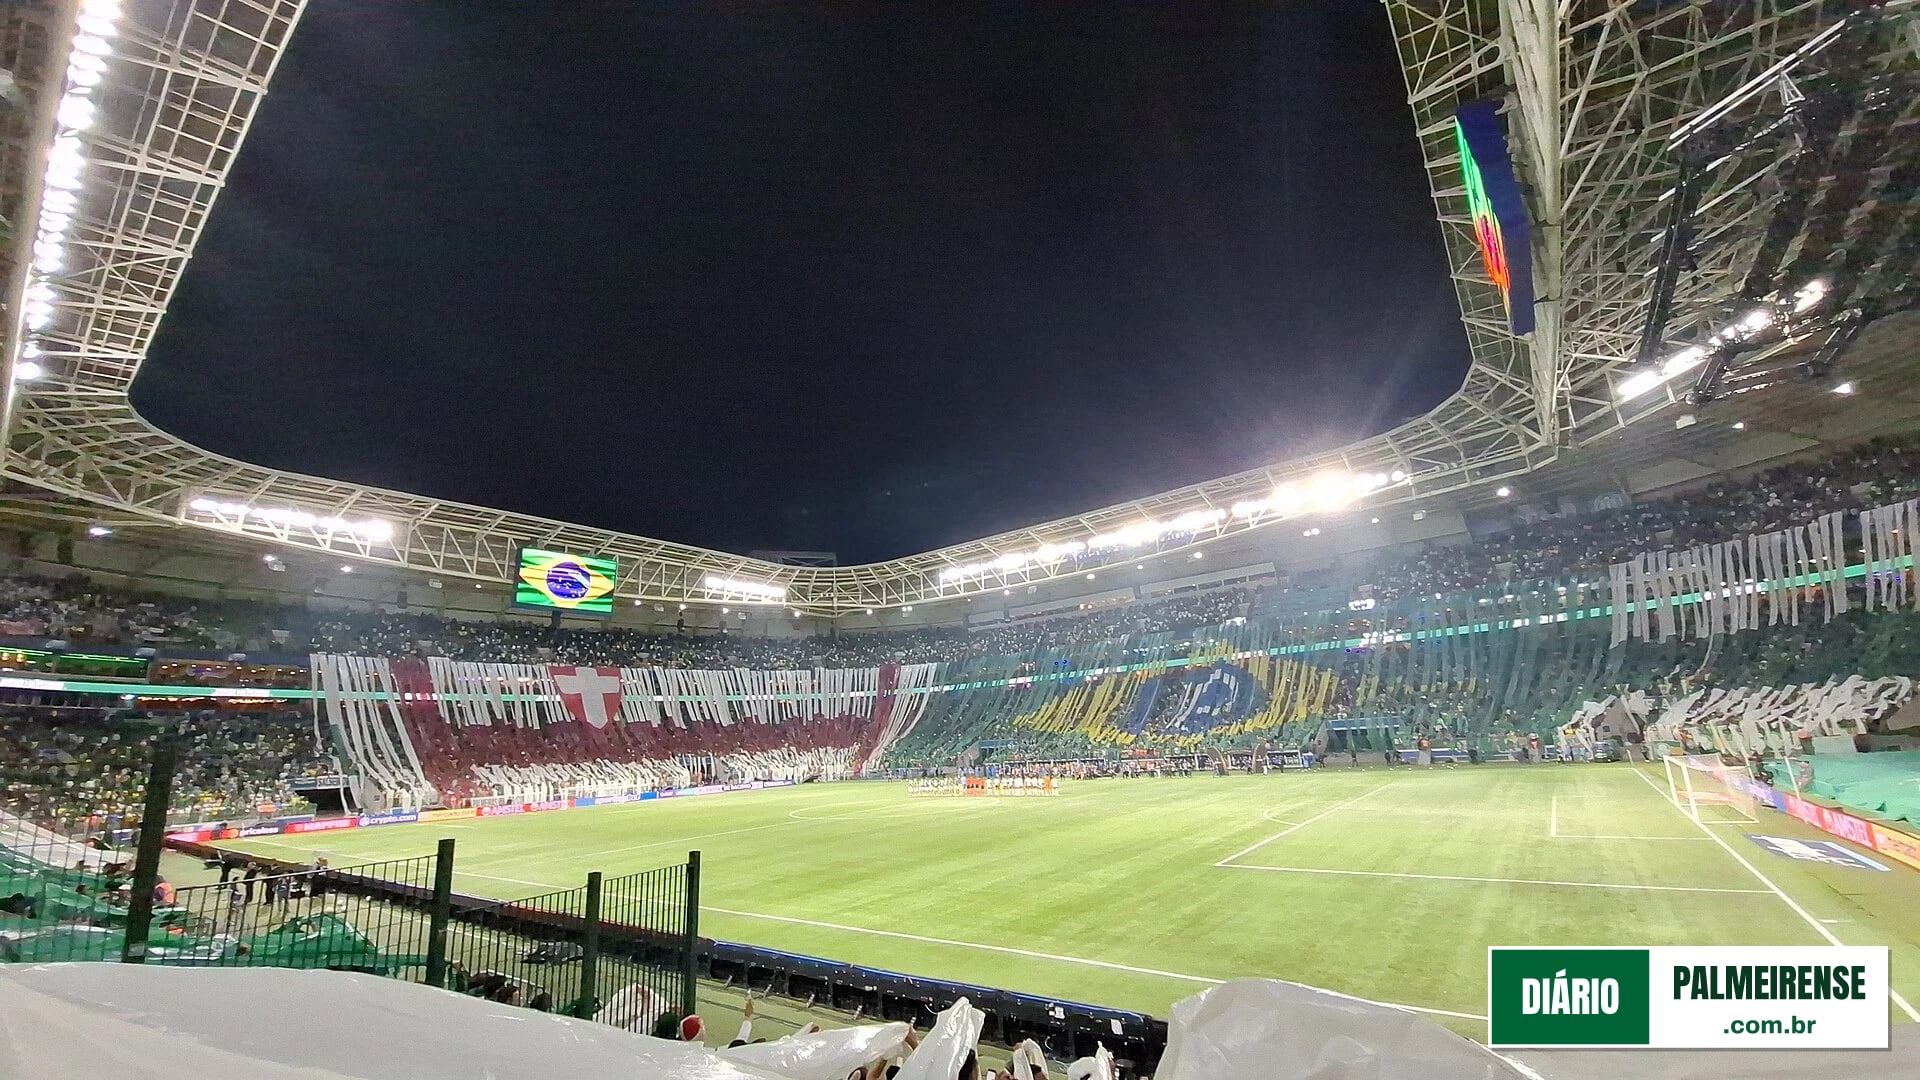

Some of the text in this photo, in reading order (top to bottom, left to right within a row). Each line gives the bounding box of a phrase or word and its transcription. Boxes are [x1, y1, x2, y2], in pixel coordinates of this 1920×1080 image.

[491, 803, 524, 815] AMSTEL
[538, 800, 568, 812] AMST
[370, 814, 417, 825] crypto.com
[239, 826, 279, 837] priceless
